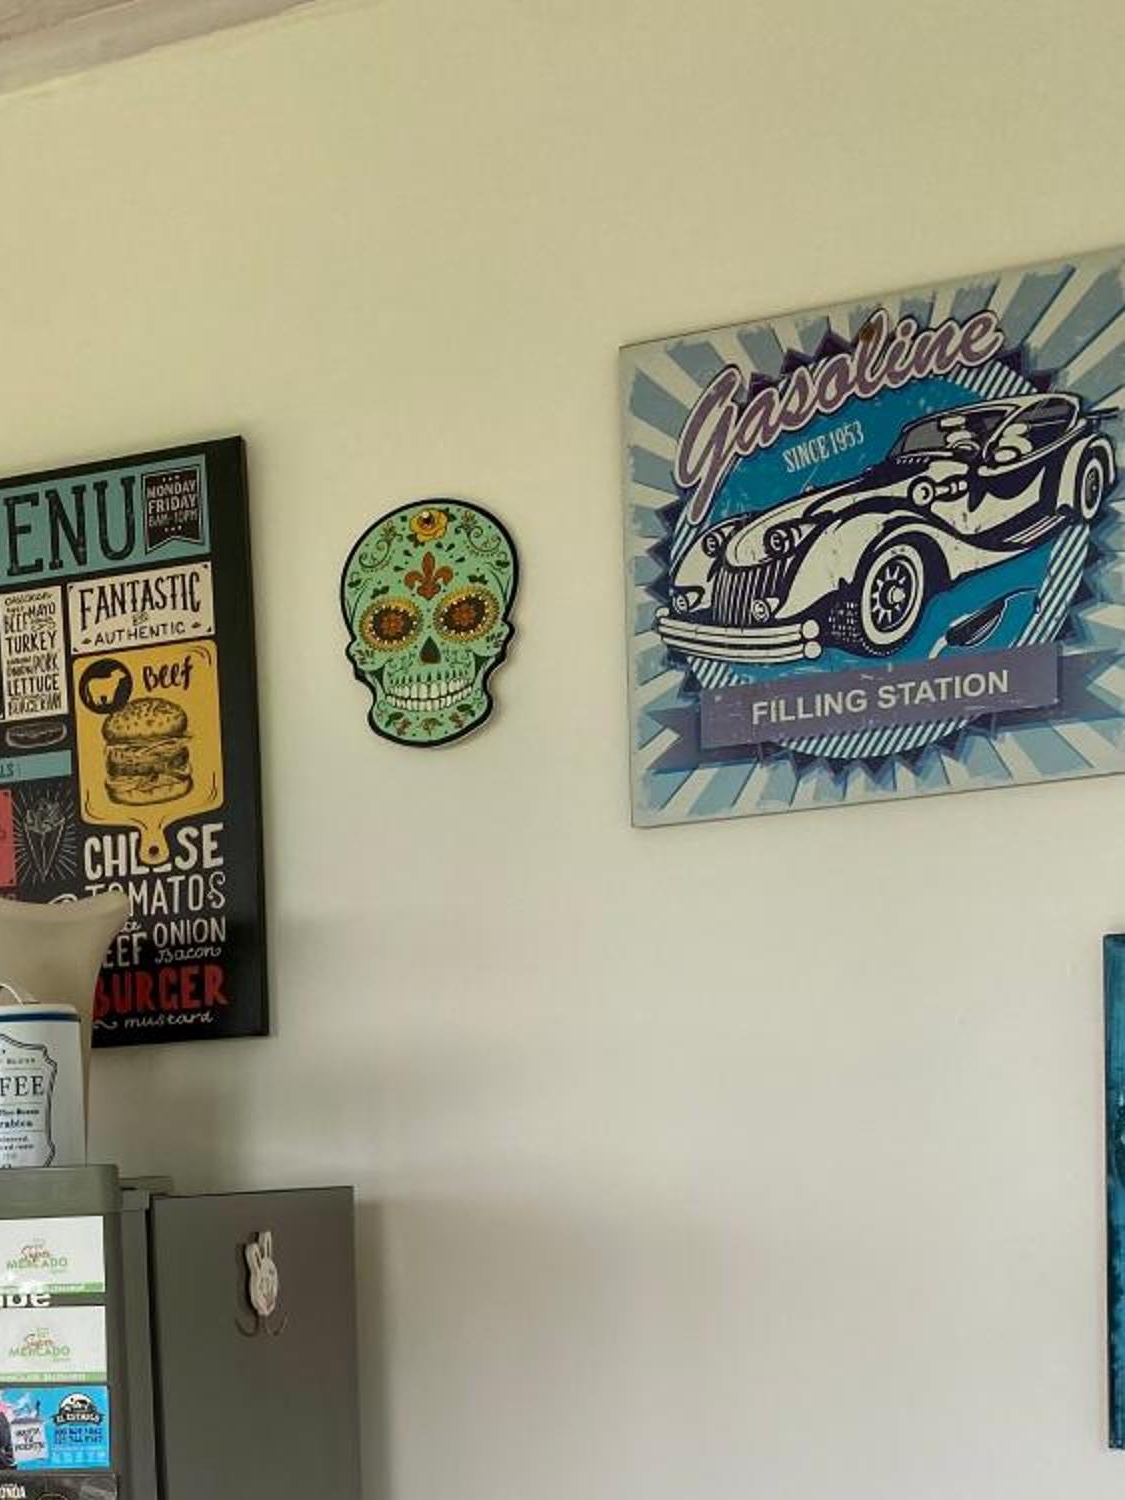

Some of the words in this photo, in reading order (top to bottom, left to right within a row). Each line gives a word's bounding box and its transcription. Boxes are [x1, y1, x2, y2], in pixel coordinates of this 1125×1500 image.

[676, 308, 1004, 525] Gasoline
[781, 440, 828, 474] SINCE
[830, 420, 865, 455] 1953
[147, 480, 196, 499] MONDAY
[148, 493, 196, 515] FRIDAY
[79, 571, 201, 632] FANTASTIC
[5, 630, 57, 656] TURKEY
[94, 620, 186, 647] AUTHENTIC
[7, 674, 60, 697] LETTUCE
[751, 687, 868, 726] FILLING
[876, 669, 1010, 711] STATION
[153, 917, 226, 948] ONION
[124, 1010, 214, 1029] mustard
[6, 1256, 69, 1270] MERCADO
[8, 1345, 71, 1358] MERCADO
